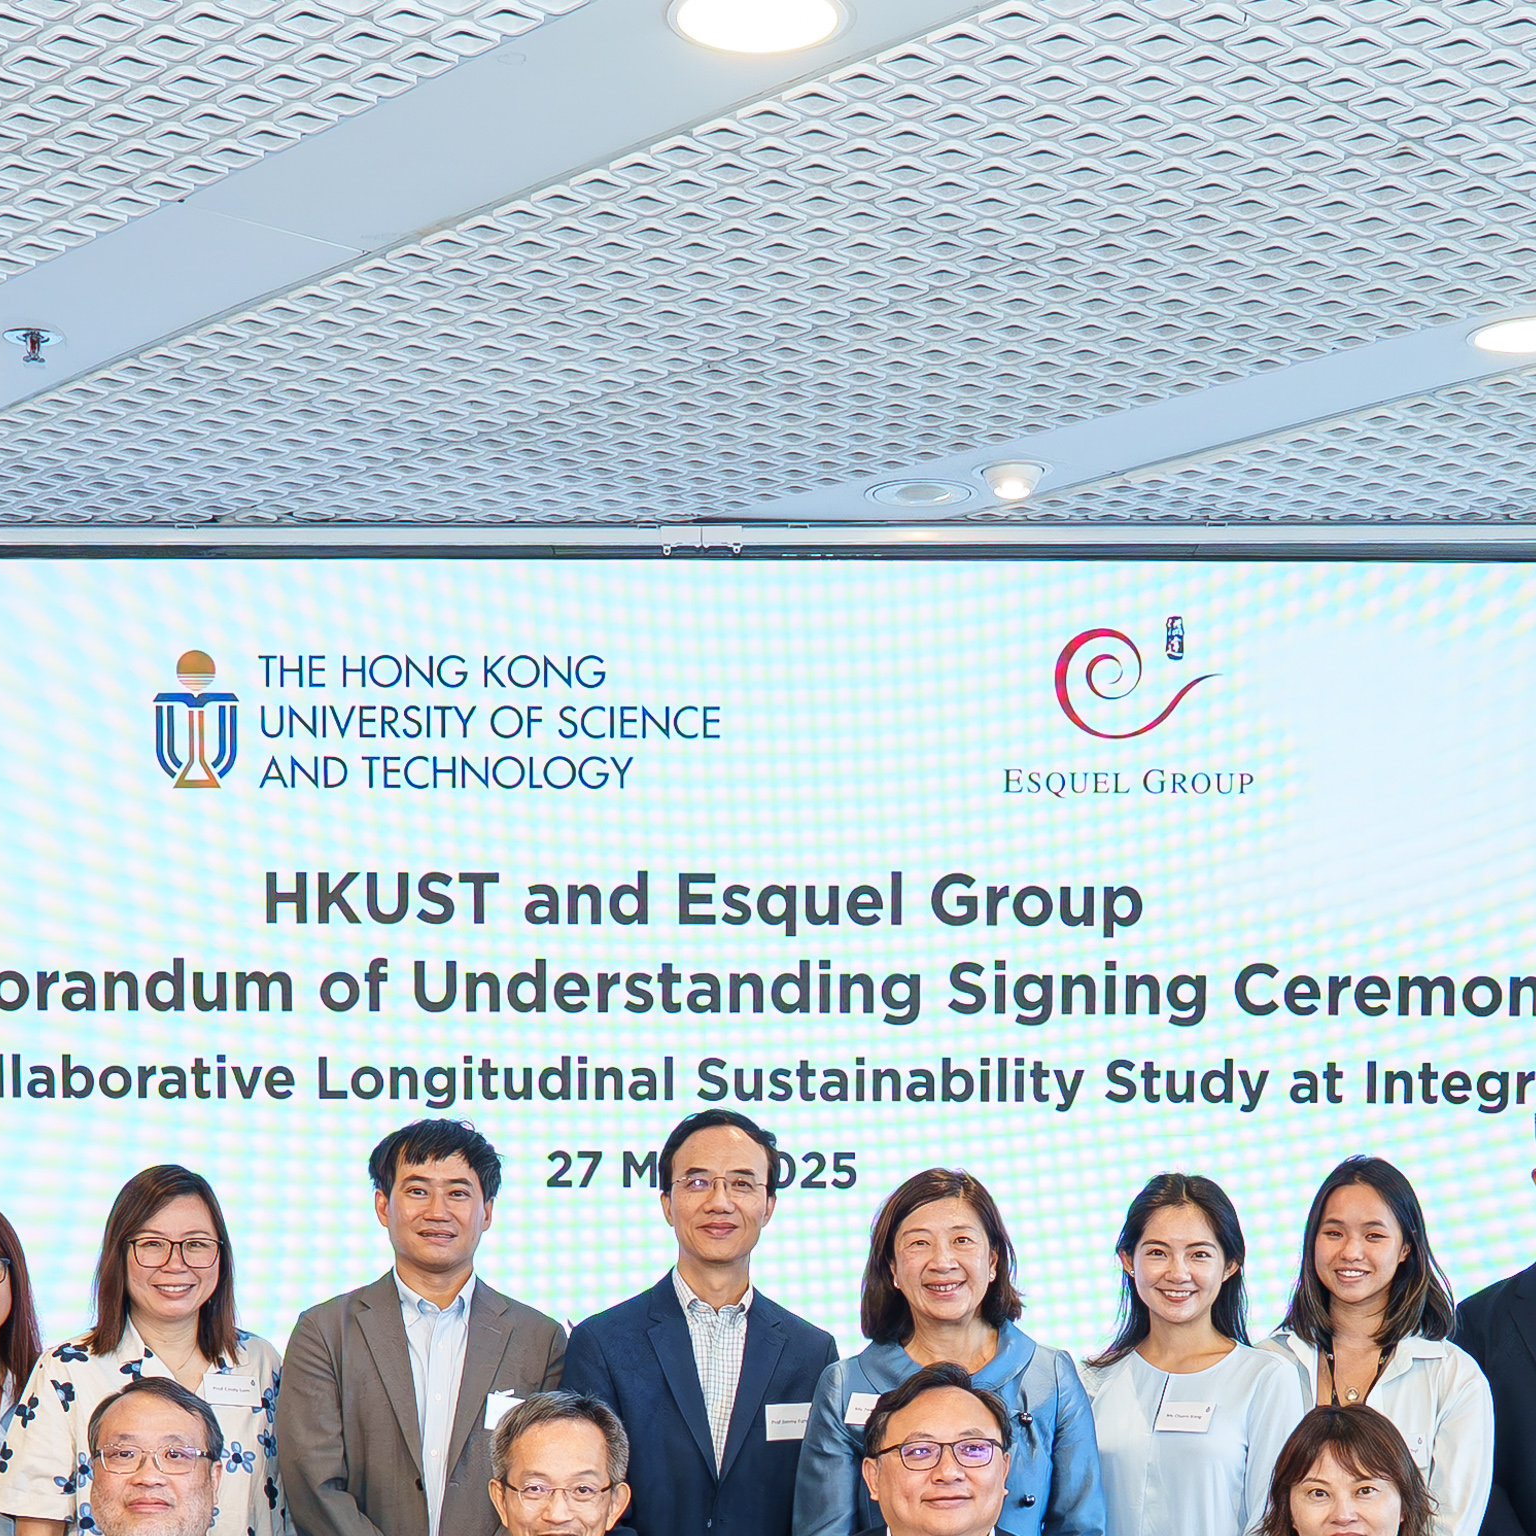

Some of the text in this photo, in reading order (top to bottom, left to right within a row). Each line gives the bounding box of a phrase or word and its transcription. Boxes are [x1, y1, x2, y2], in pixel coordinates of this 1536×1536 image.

[259, 654, 607, 690] THE HONG KONG
[260, 704, 721, 740] UNIVERSITY OF SCIENCE
[258, 754, 634, 790] AND TECHNOLOGY
[1002, 768, 1254, 799] ESQUEL GROUP
[265, 870, 1143, 939] HKUST and Esquel Group
[319, 957, 388, 1013] of
[413, 958, 921, 1026] Understanding
[947, 959, 1207, 1027] Signing
[318, 1055, 675, 1109] Longitudinal
[696, 1056, 1084, 1112] Sustainability
[1104, 1058, 1270, 1113] Study
[1289, 1061, 1344, 1104] at
[546, 1150, 603, 1188] 27
[776, 1151, 857, 1189] 025
